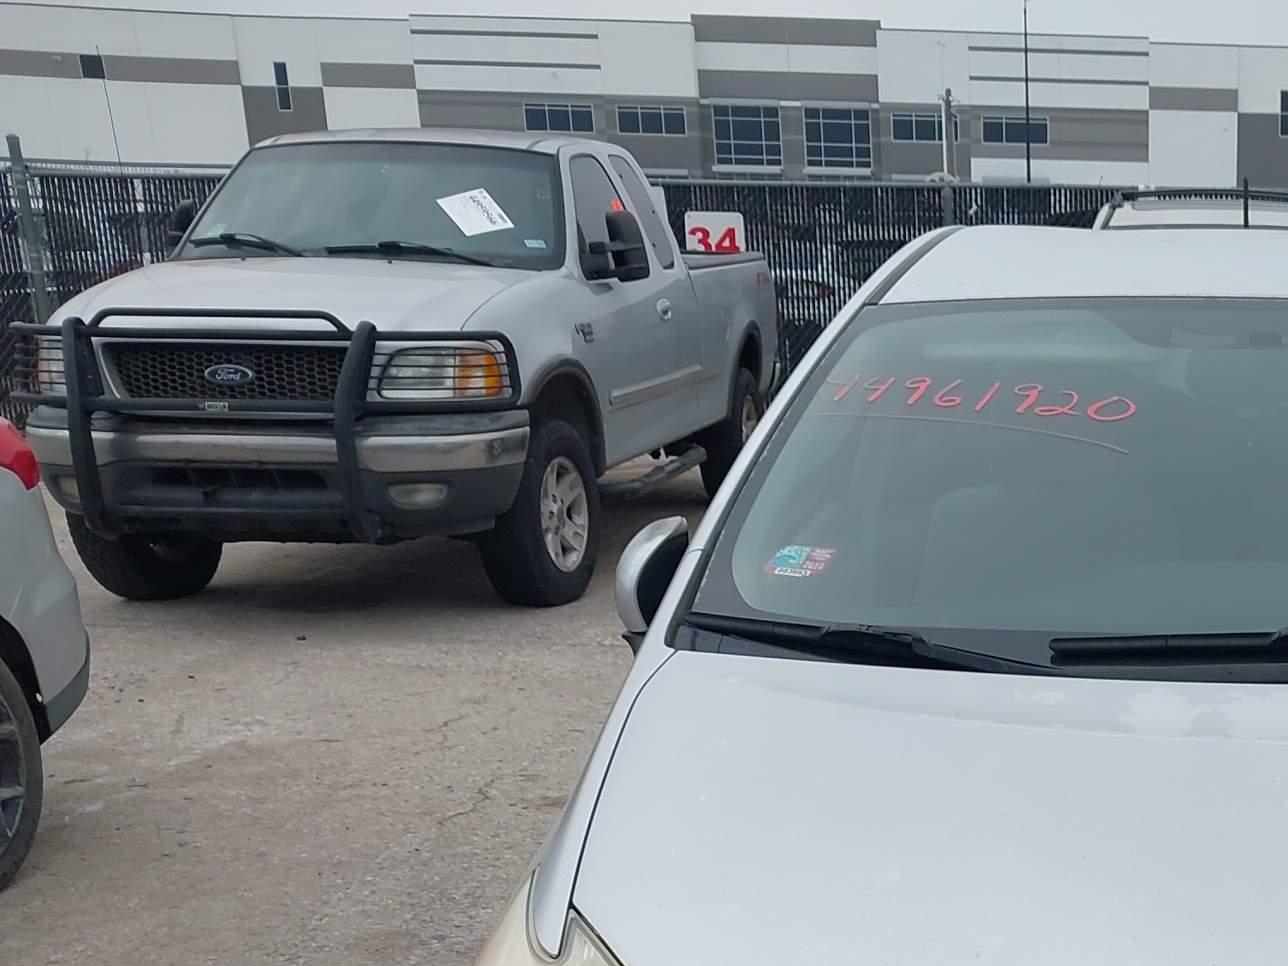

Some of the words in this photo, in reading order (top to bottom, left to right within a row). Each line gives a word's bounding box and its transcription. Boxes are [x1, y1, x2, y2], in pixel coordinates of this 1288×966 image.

[688, 226, 741, 254] 34
[215, 368, 242, 380] Ford
[826, 373, 1137, 422] 44961920
